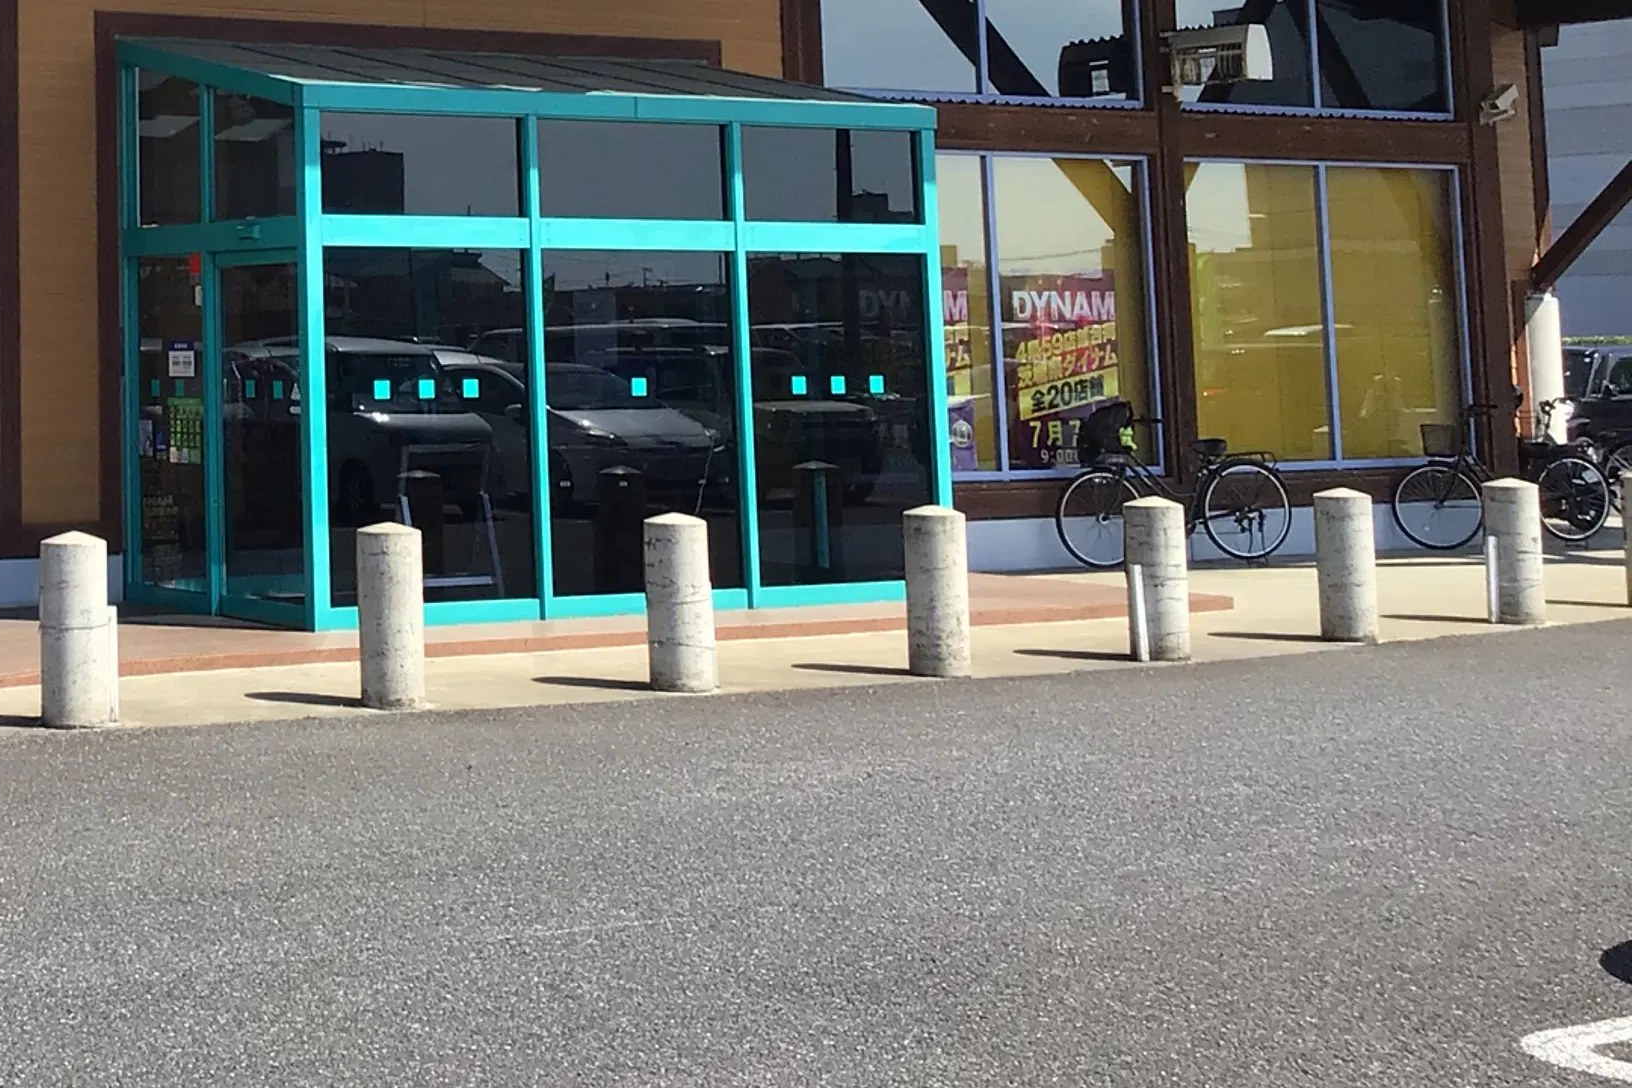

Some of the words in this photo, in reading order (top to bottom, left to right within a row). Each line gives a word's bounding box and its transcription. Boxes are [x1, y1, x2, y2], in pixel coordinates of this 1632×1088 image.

[1012, 291, 1116, 321] DYNAM
[1031, 374, 1104, 412] 全20店舗
